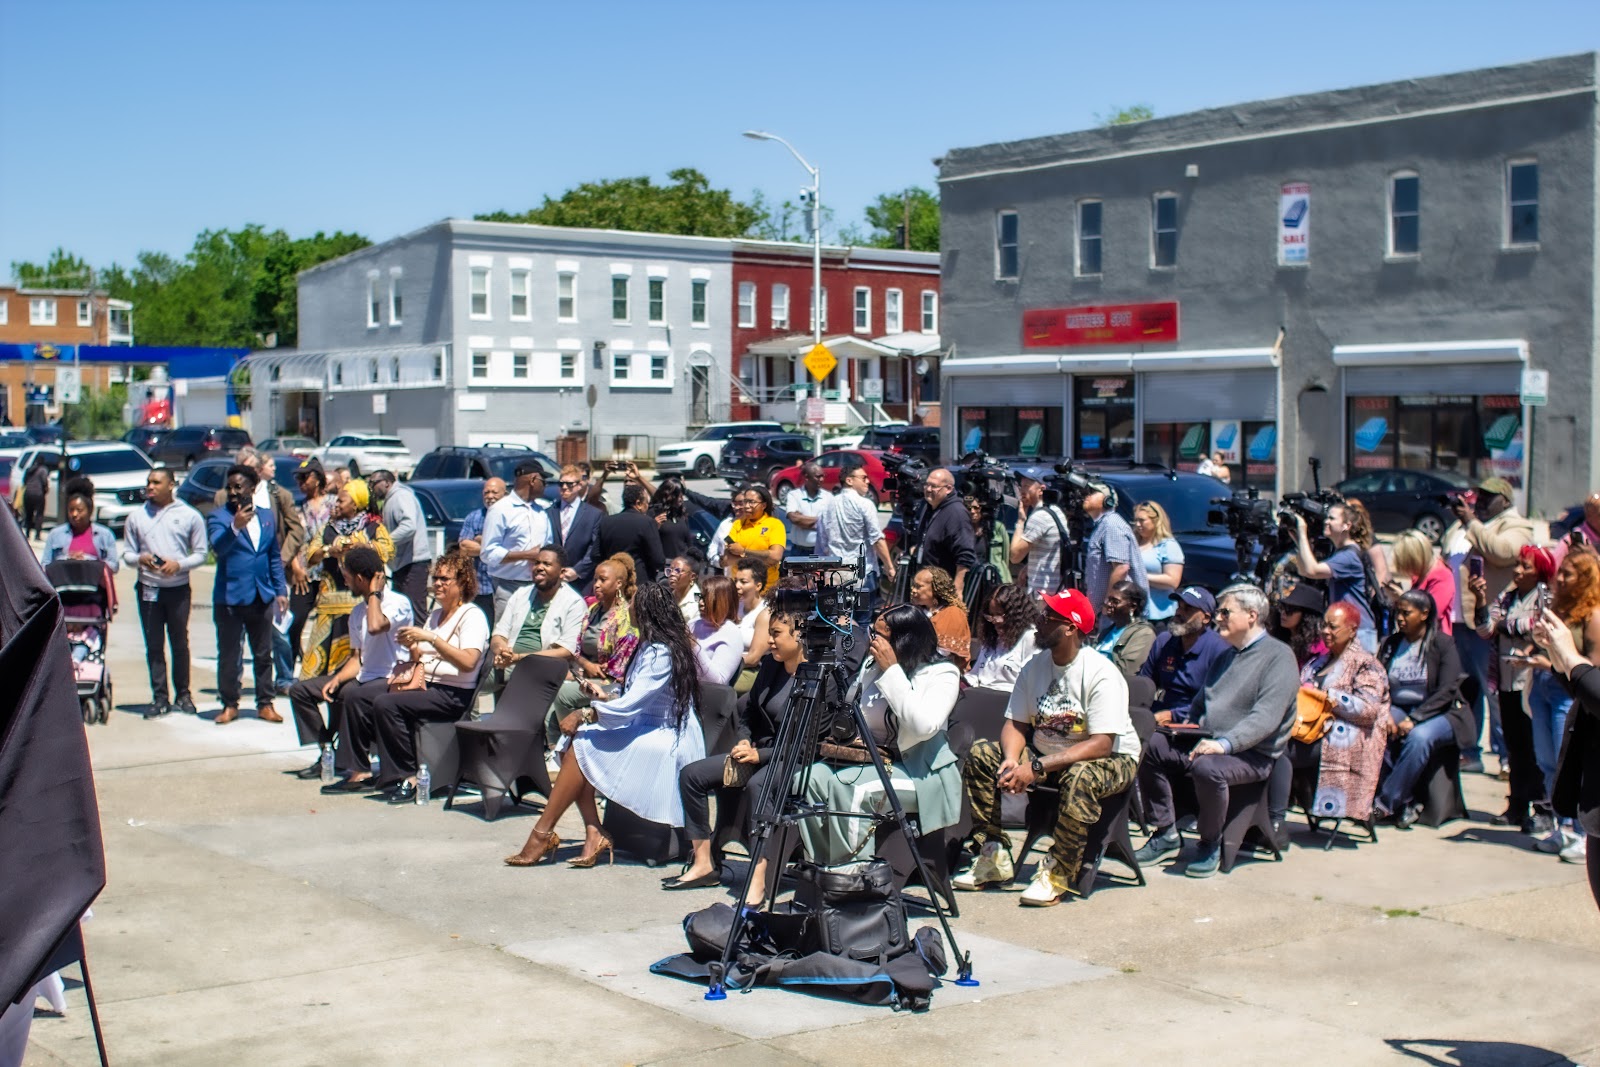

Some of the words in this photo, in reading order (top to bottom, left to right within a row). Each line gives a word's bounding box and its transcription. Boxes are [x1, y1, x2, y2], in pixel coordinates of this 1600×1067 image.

[1283, 234, 1306, 245] SALE
[1066, 312, 1106, 329] MATTRESS
[1110, 311, 1132, 327] SPOT
